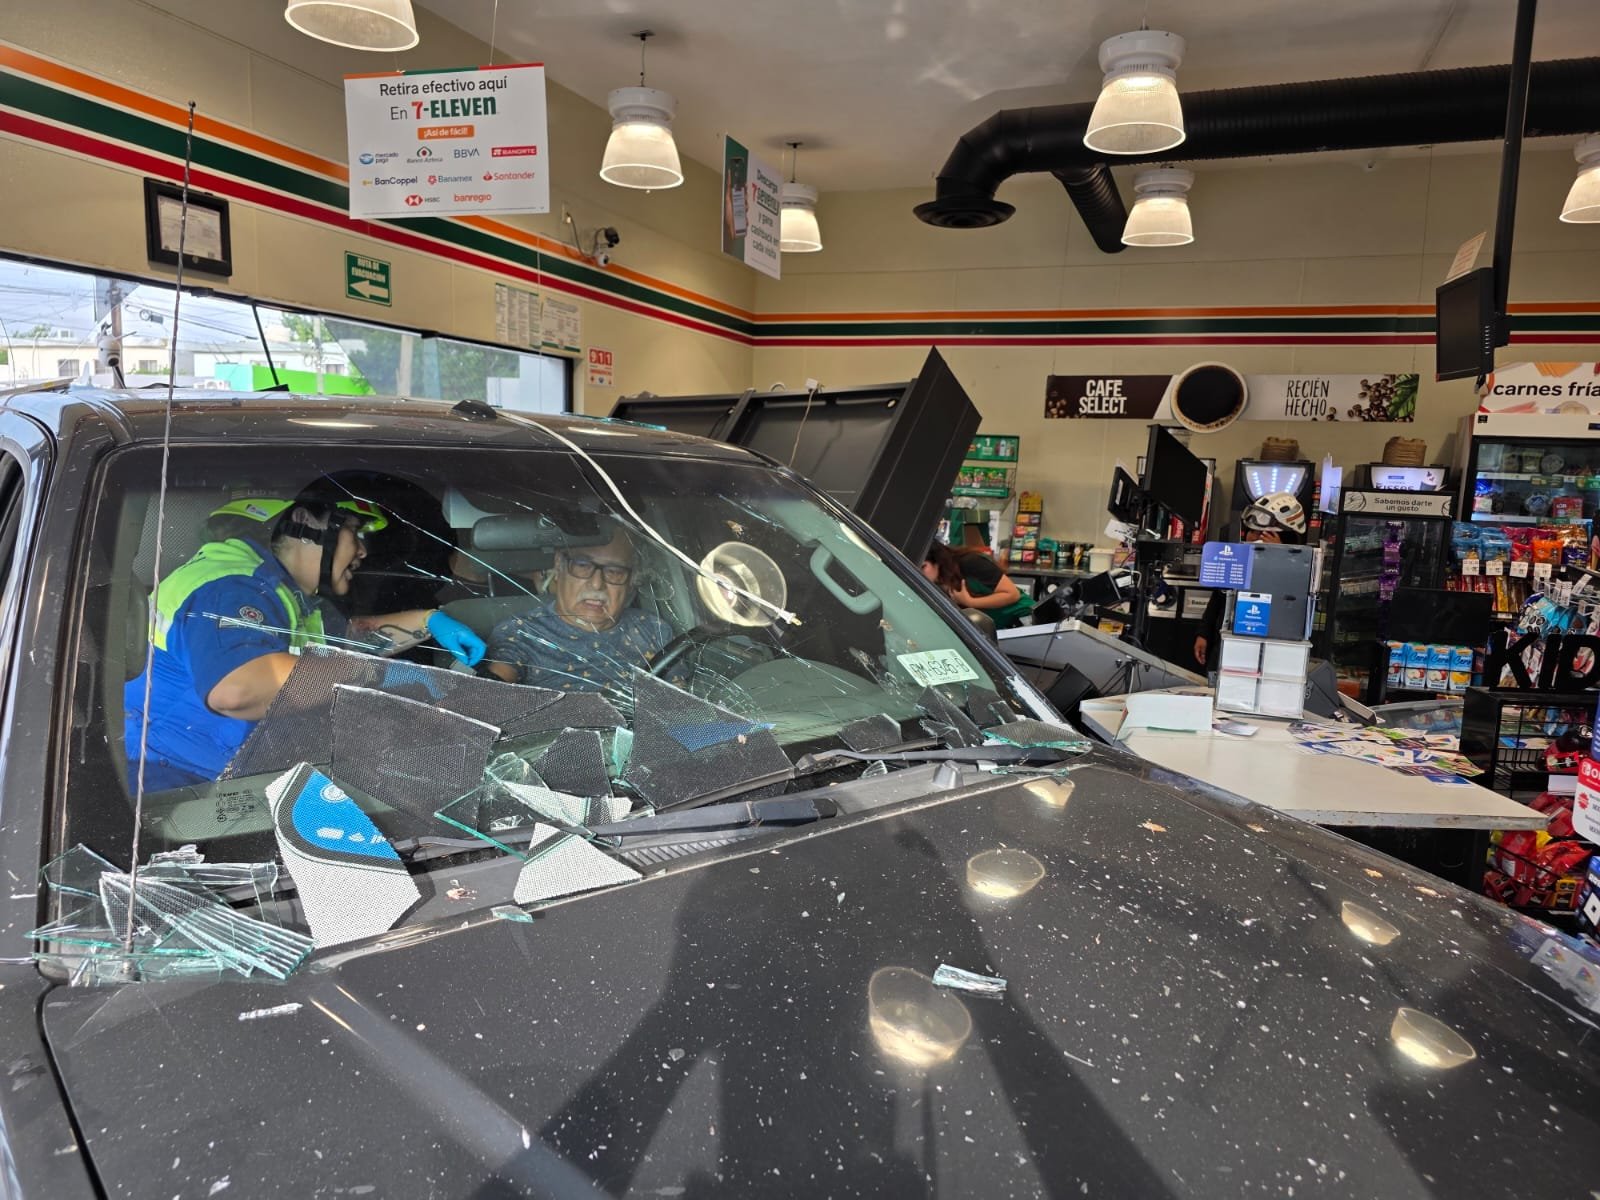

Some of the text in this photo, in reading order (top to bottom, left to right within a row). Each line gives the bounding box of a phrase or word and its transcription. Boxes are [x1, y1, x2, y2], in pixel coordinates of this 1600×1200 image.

[380, 75, 507, 96] Retira efectivo aquí
[390, 106, 408, 120] En
[454, 148, 480, 158] BBVA
[374, 175, 418, 186] BanCoppel
[438, 175, 473, 183] Banamex
[493, 171, 535, 180] Santander
[454, 194, 492, 203] banregio
[590, 350, 612, 366] 911
[1493, 384, 1563, 397] carnes
[1079, 396, 1128, 414] SELECT
[1285, 398, 1327, 417] HECHO
[1374, 498, 1433, 507] Sabemos darte
